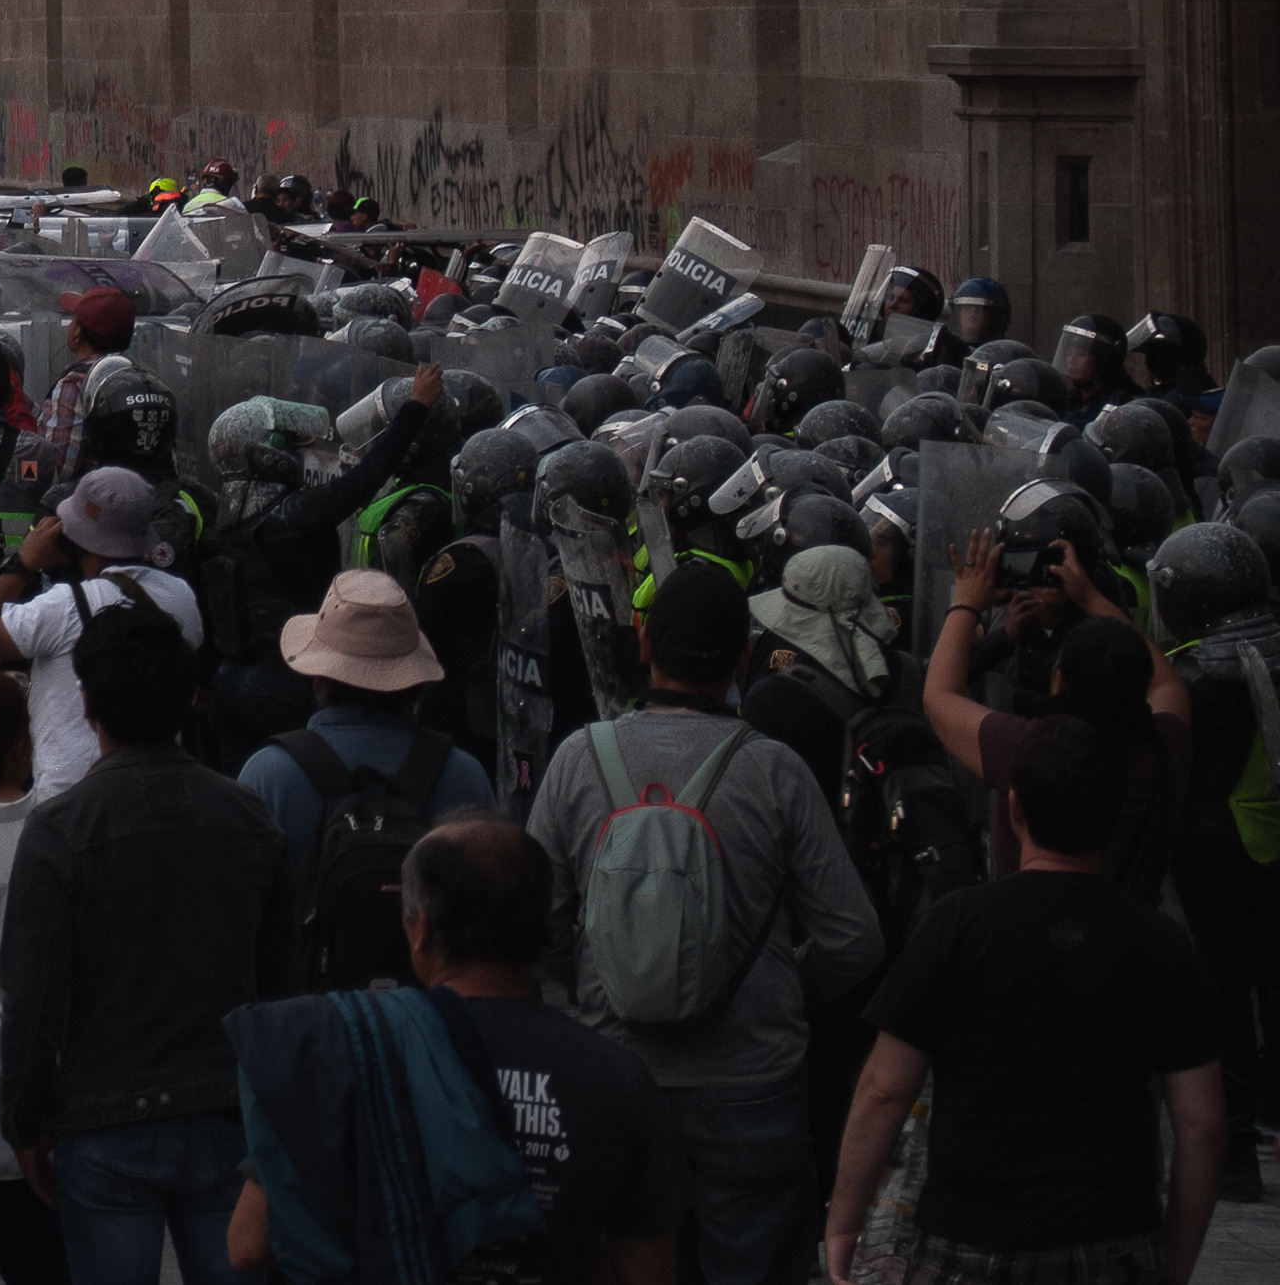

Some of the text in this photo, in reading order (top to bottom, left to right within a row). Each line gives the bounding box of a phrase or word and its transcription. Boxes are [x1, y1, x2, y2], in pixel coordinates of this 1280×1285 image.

[505, 267, 564, 299] OLICIA
[668, 250, 727, 296] OLICIA
[513, 1103, 568, 1138] THIS.
